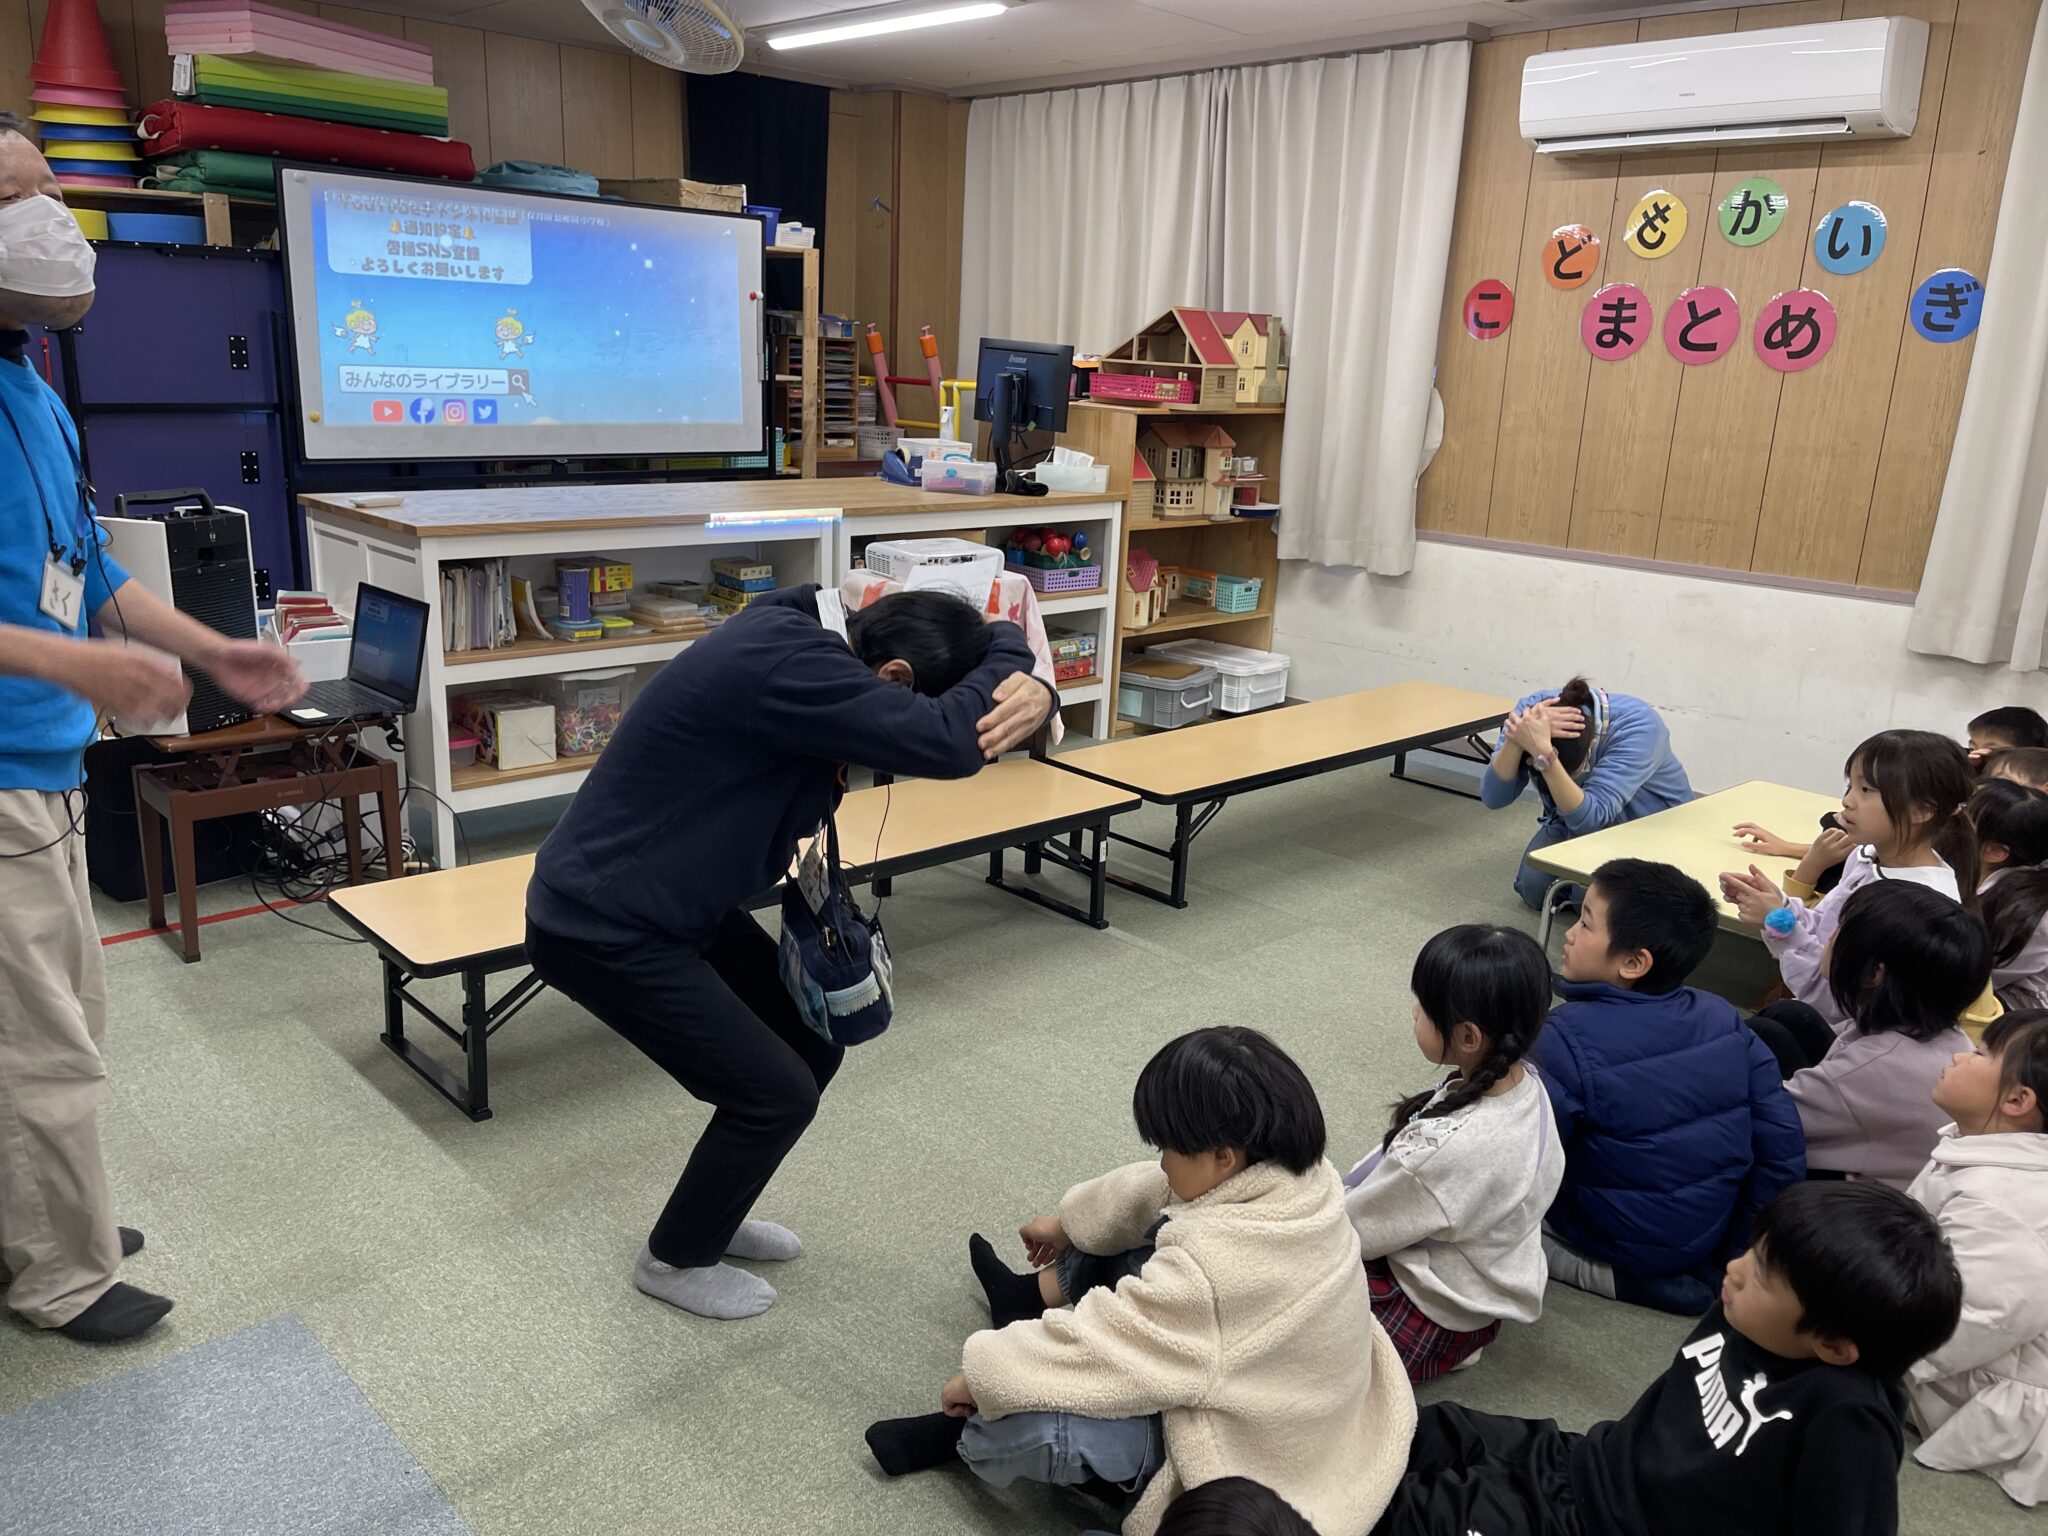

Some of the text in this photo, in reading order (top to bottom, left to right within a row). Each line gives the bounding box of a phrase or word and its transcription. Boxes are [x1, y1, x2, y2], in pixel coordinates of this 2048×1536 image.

[361, 257, 504, 281] よろしくお願いします
[1595, 297, 1821, 360] まとめ
[345, 371, 506, 390] みんなのライブラリー
[1681, 1332, 1744, 1449] PUMA
